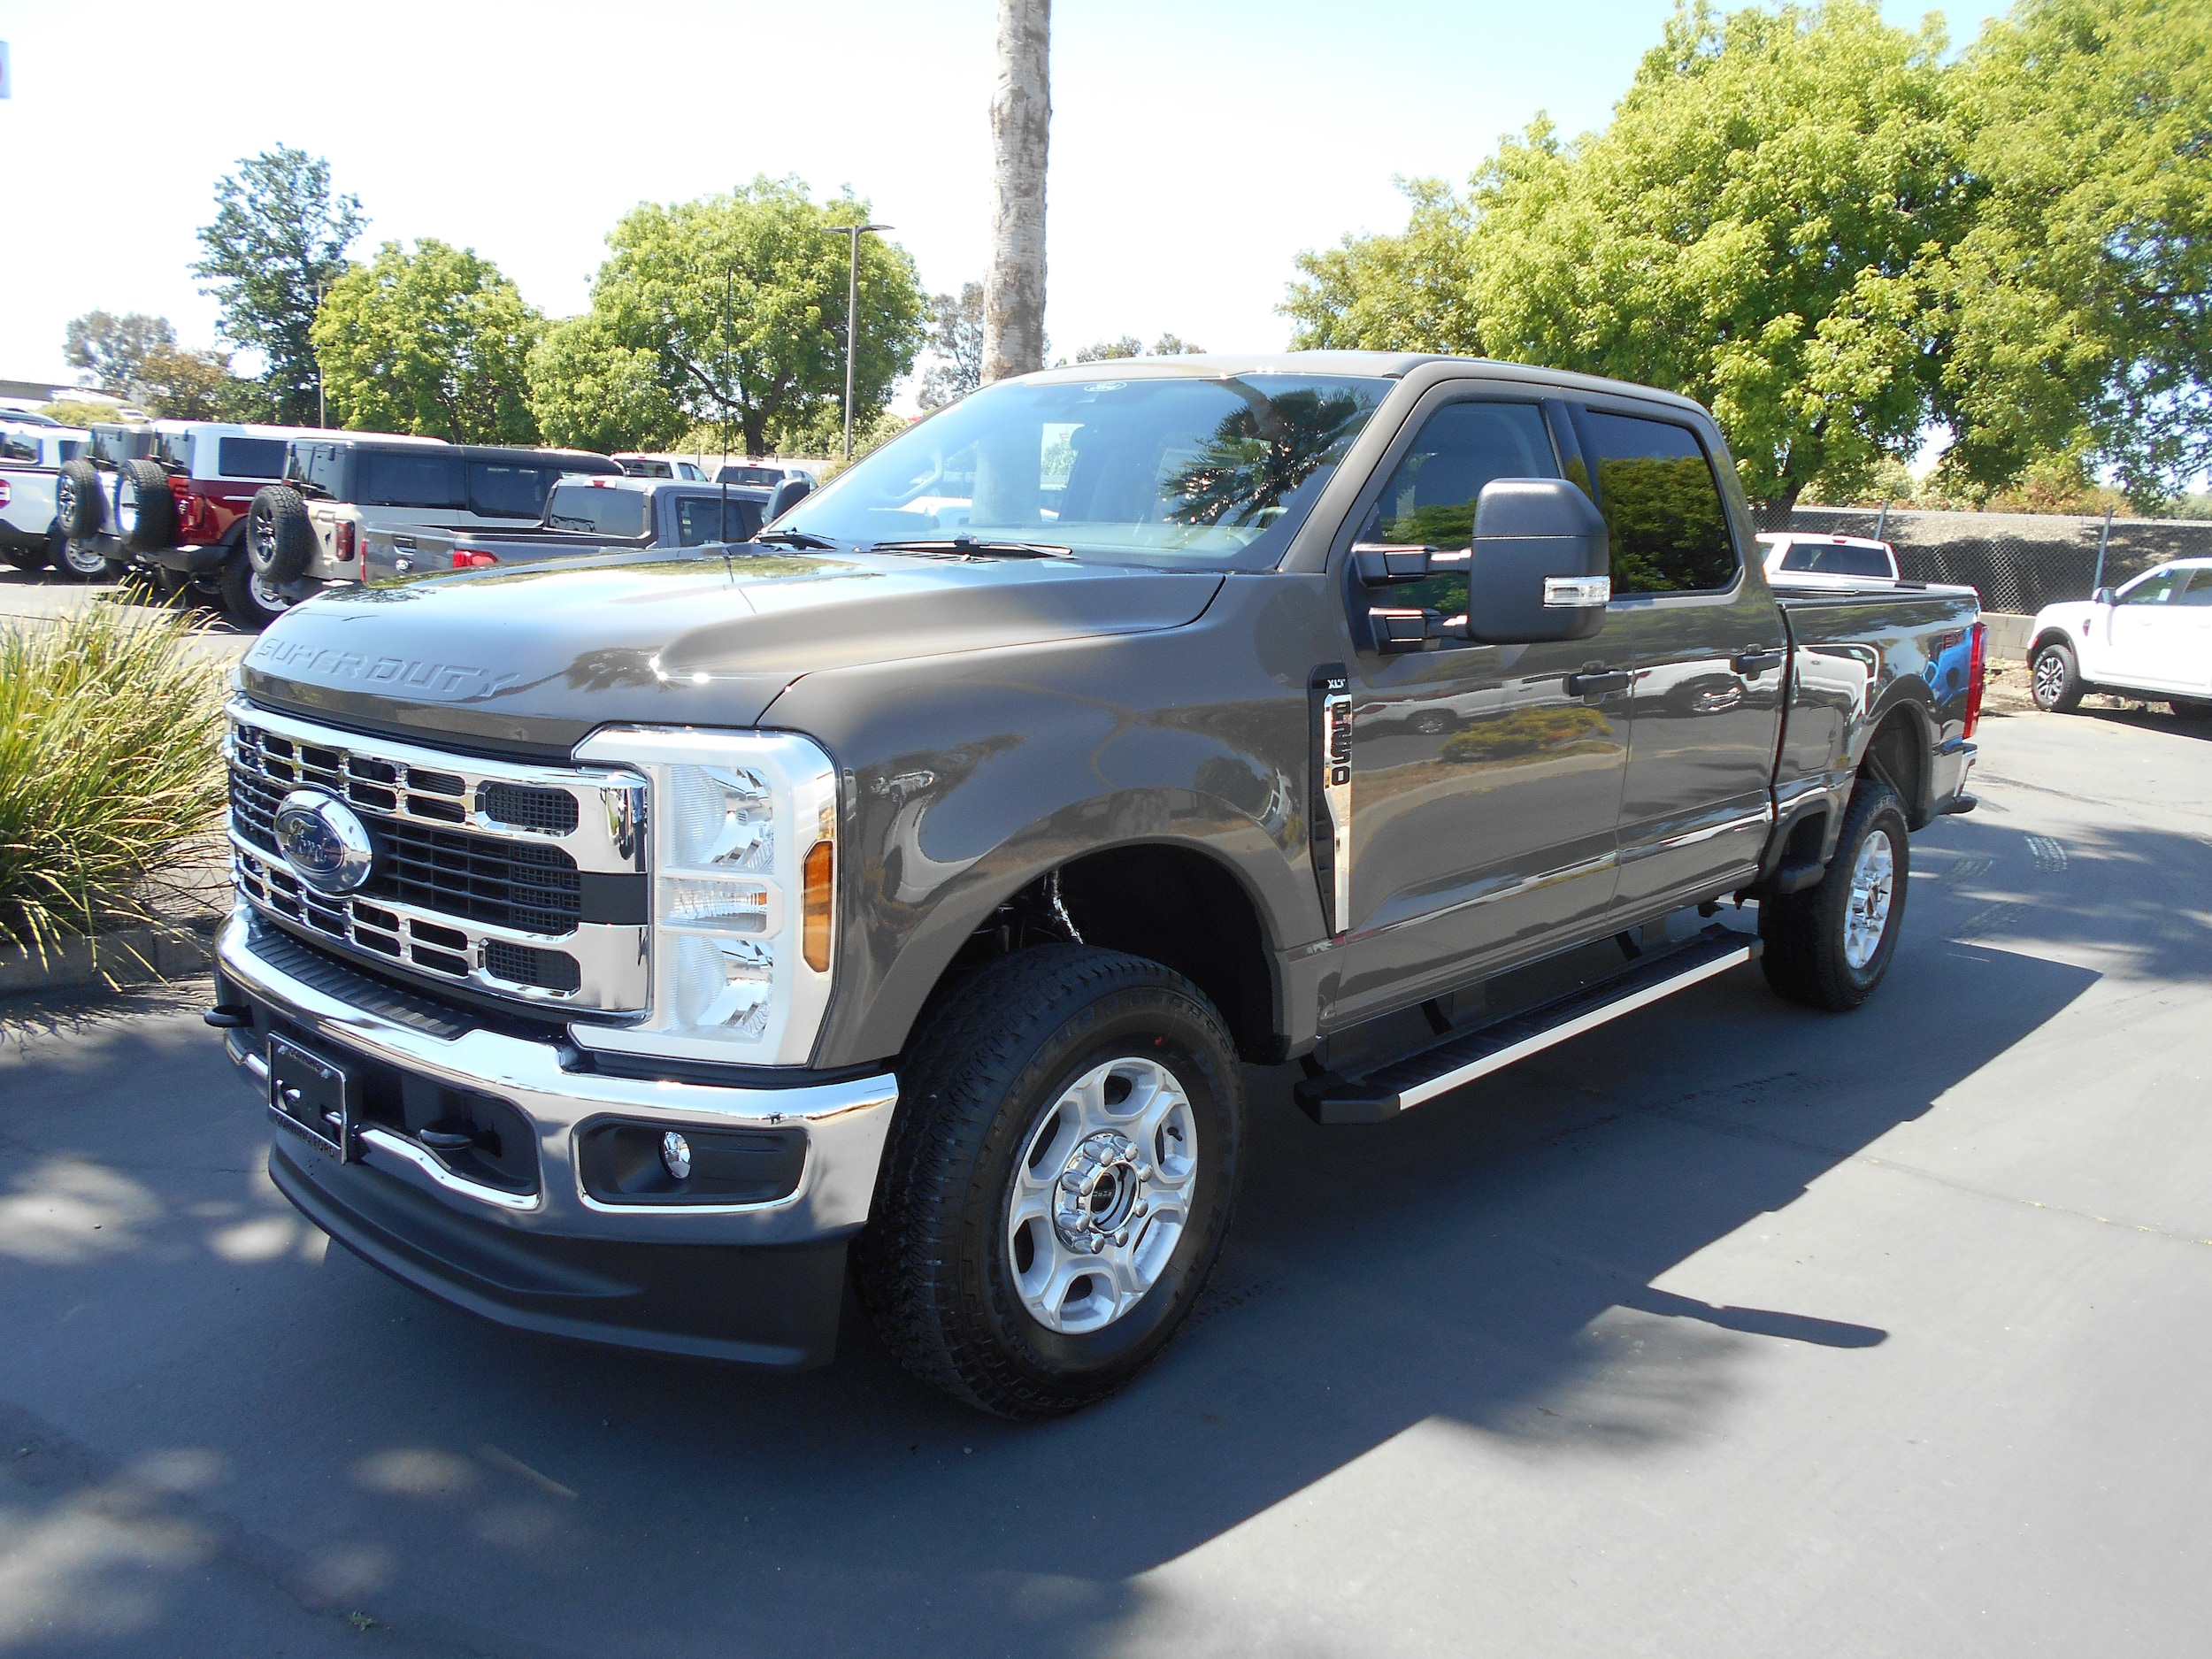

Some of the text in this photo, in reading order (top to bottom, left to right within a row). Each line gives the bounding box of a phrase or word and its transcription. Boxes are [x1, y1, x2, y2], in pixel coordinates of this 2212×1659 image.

[255, 637, 520, 697] SUPER DUTY
[1327, 678, 1346, 689] XLT
[286, 817, 330, 864] Ford
